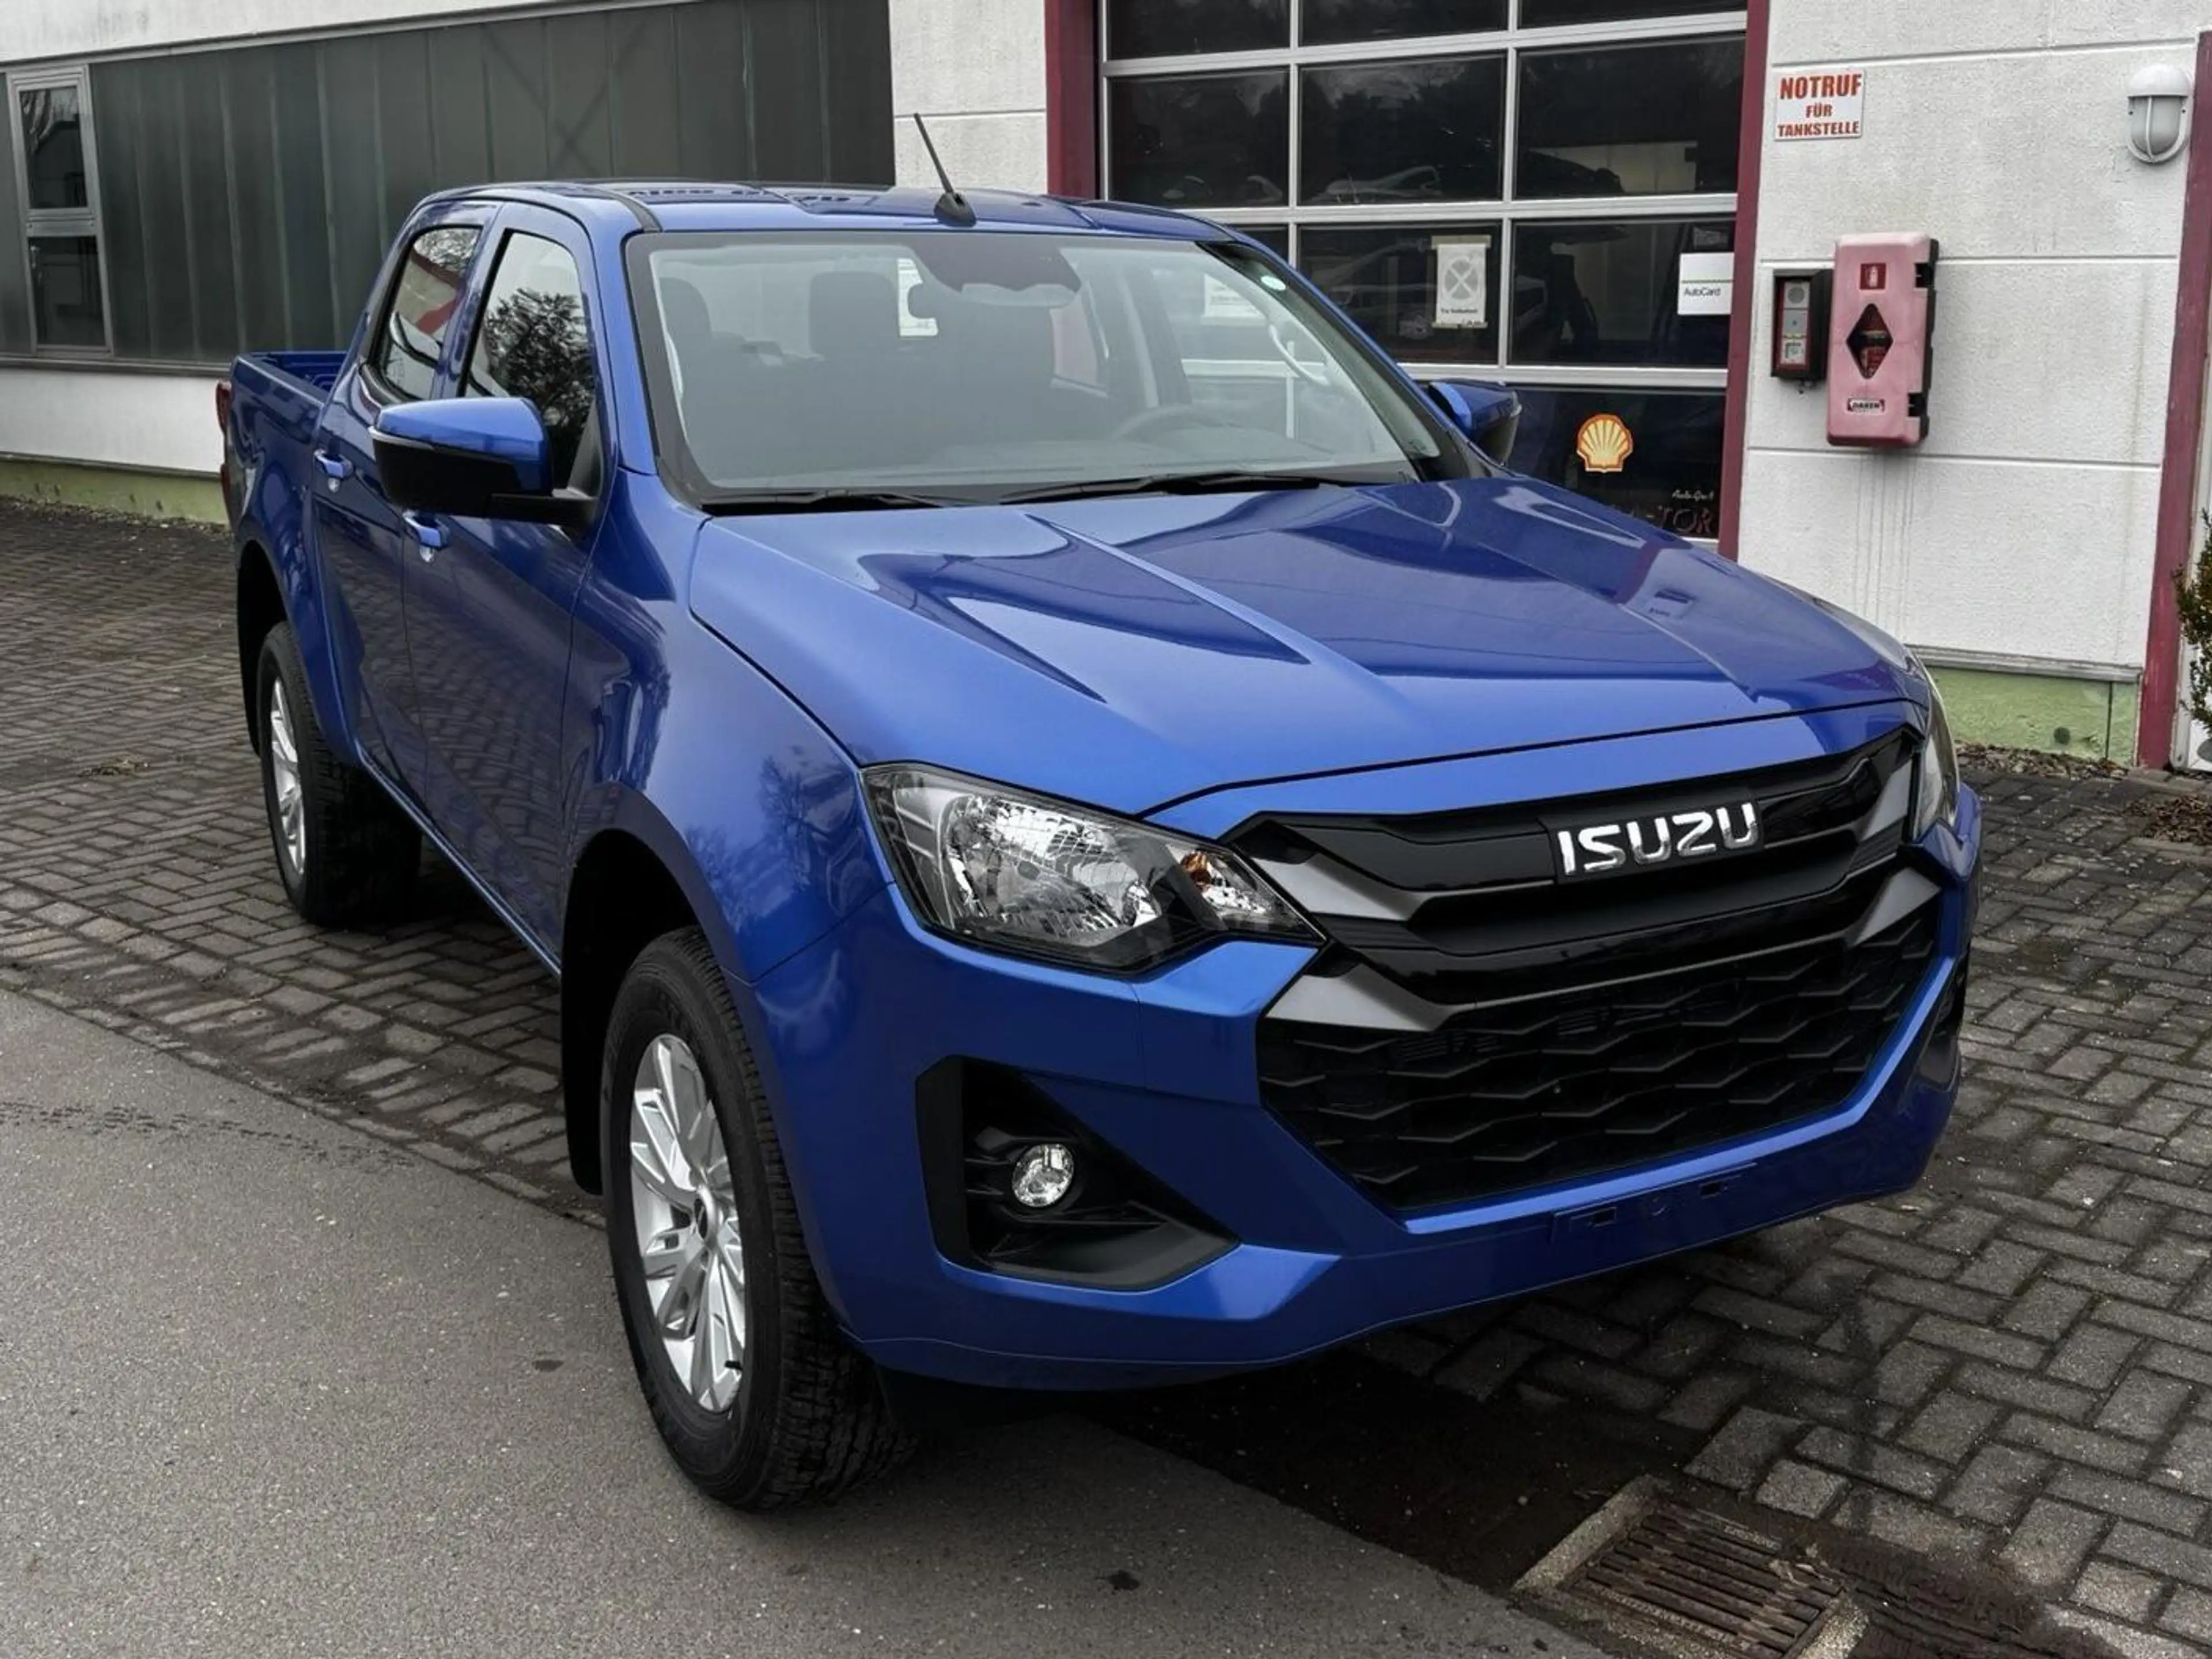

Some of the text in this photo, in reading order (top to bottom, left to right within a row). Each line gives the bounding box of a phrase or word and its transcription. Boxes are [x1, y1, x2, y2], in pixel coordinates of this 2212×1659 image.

[1780, 74, 1862, 100] NOTRUF
[1806, 102, 1832, 118] FÜR
[1778, 121, 1859, 137] TANKSTELLE
[1684, 287, 1721, 297] AutoCard
[1558, 802, 1758, 875] ISUZU
